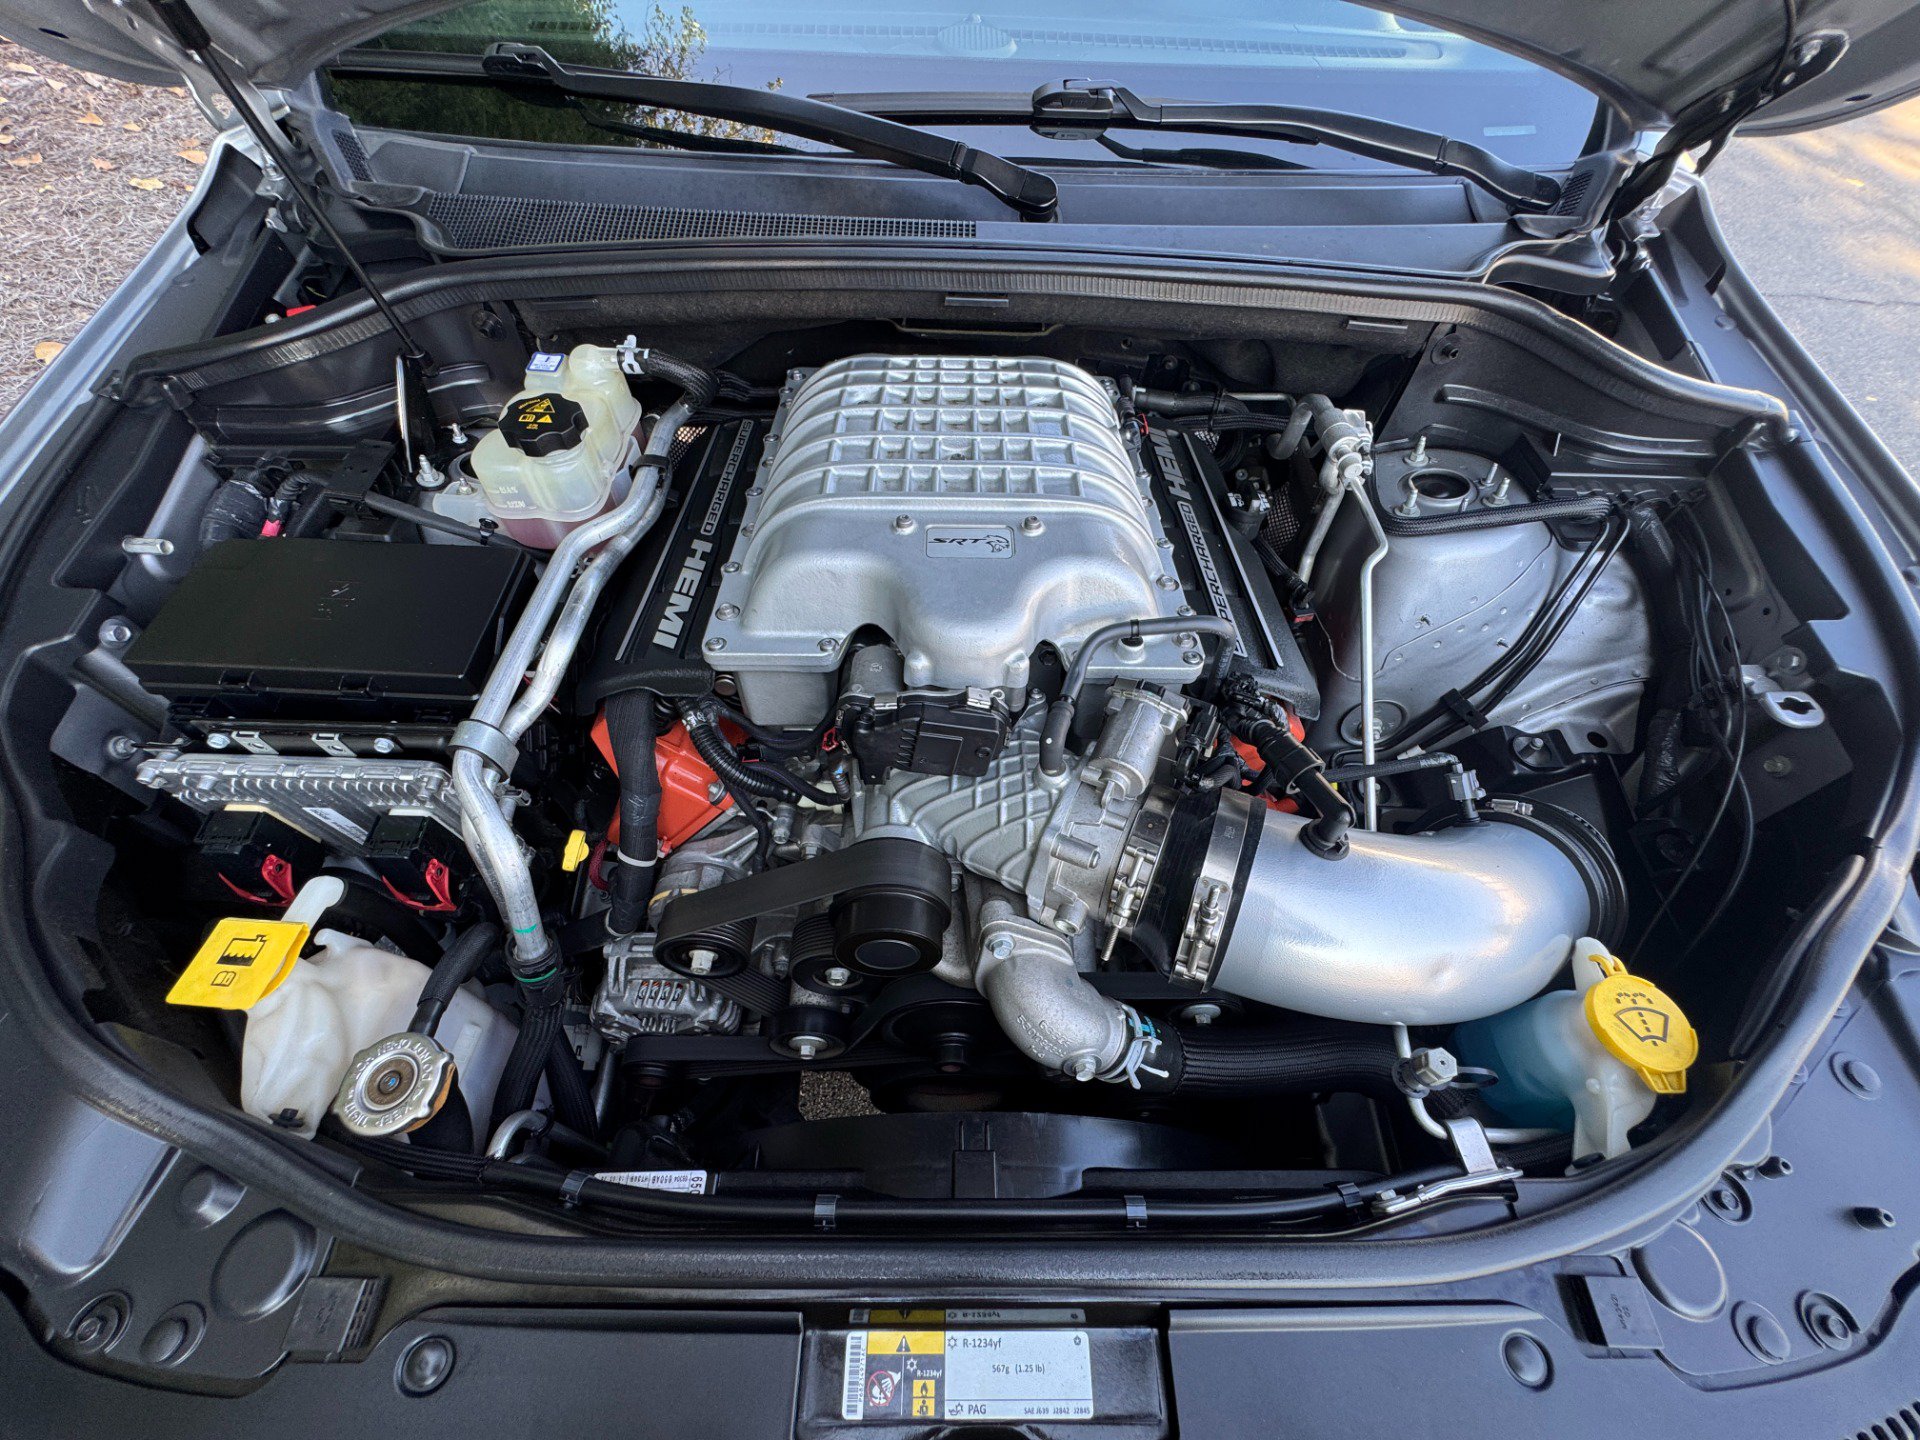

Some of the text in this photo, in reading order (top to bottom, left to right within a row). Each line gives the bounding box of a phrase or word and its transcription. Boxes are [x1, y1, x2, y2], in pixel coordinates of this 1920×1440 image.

[653, 421, 752, 650] SUPERCHARGED HEMI
[928, 537, 987, 546] SRT
[1149, 428, 1244, 655] PERCHARGED HEMI
[963, 1337, 1002, 1350] R-1234yf
[916, 1369, 942, 1379] R-1234yf
[992, 1364, 1045, 1374] 567g (1.25 lb)
[968, 1404, 987, 1415] PAG
[1024, 1407, 1034, 1415] SAE
[1053, 1407, 1070, 1415] J2842
